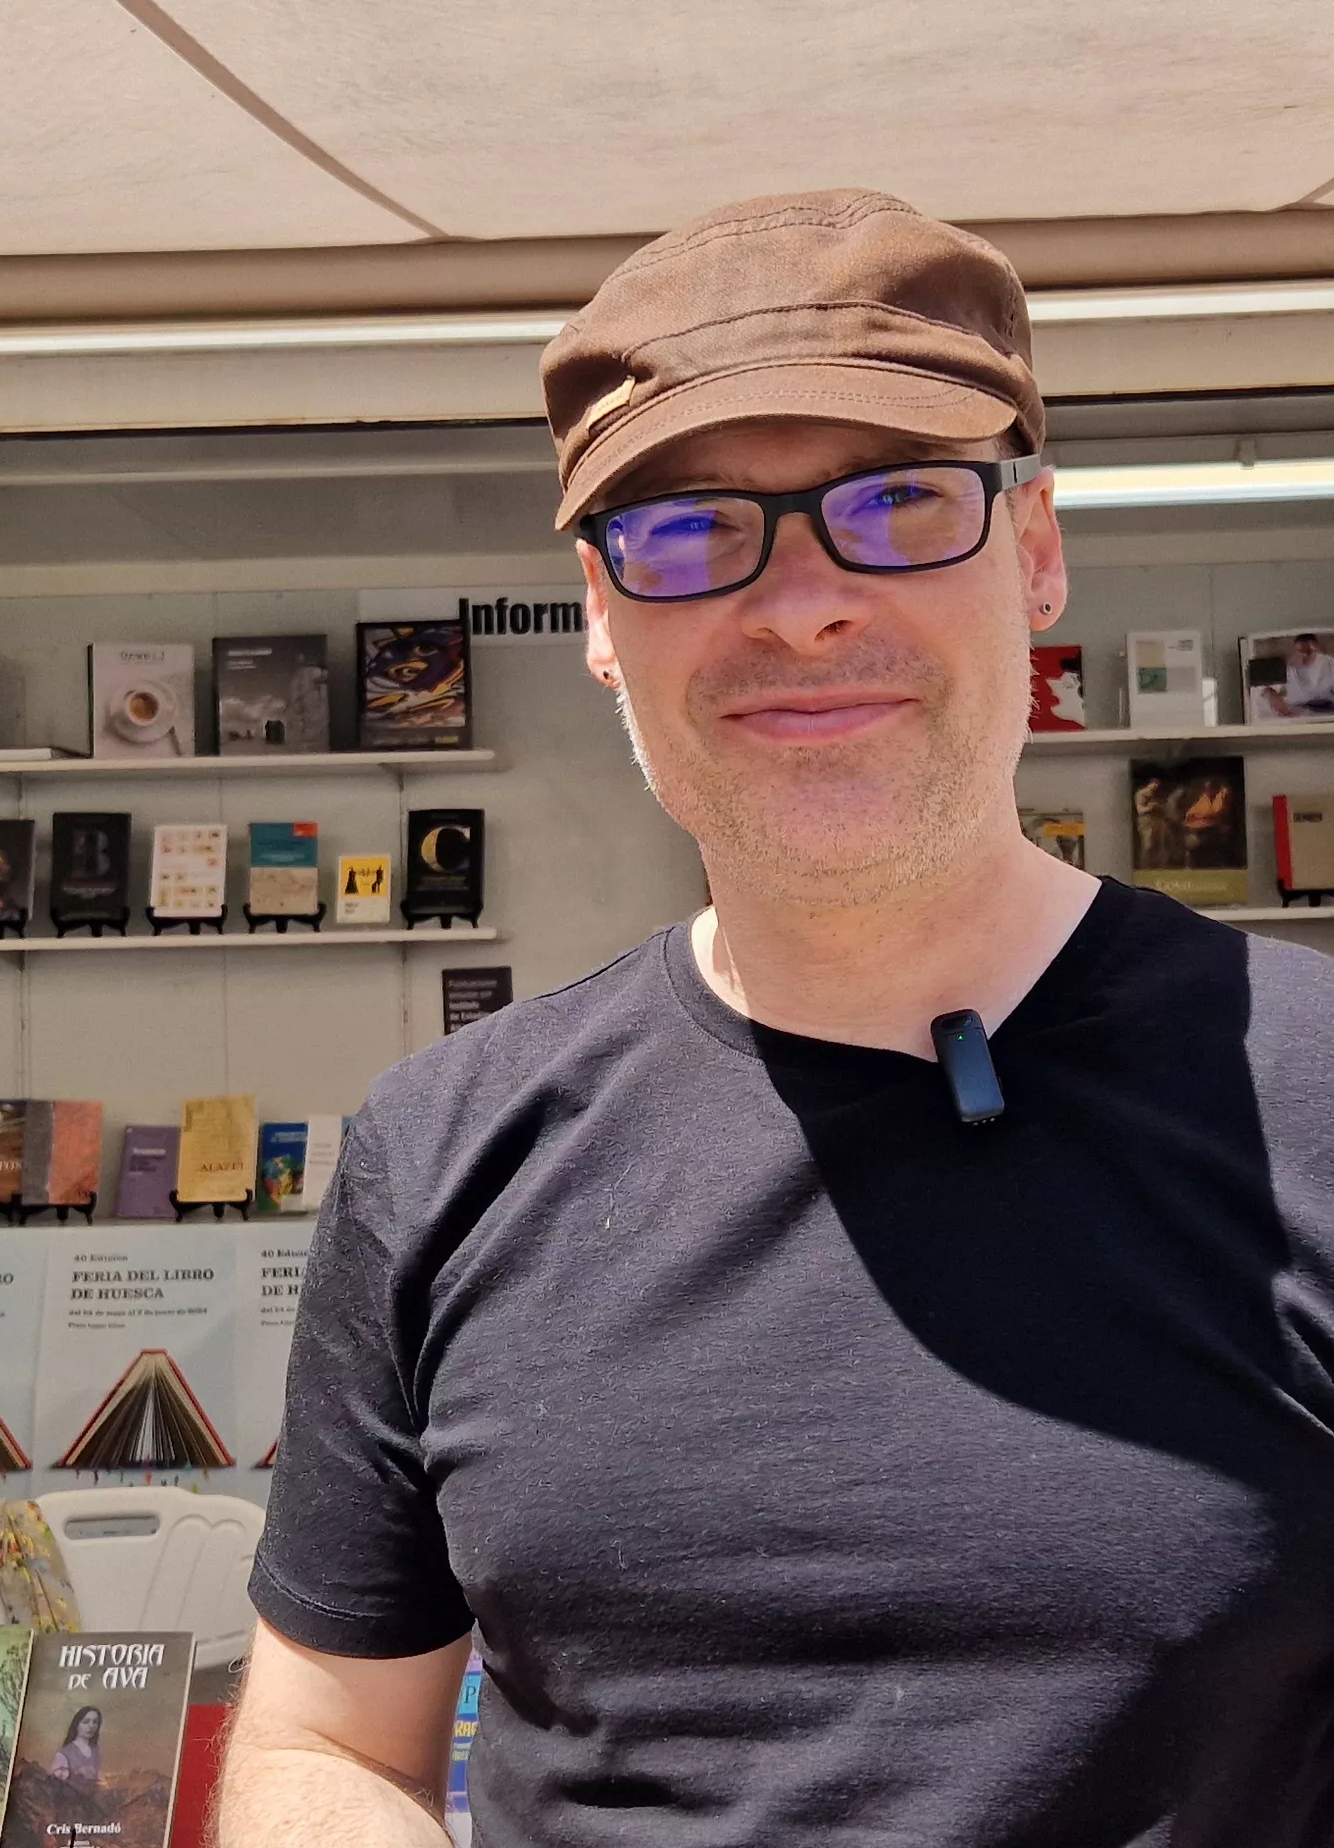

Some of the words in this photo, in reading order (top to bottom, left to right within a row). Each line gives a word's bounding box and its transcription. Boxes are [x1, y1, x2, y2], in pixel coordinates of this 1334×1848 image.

[458, 596, 583, 635] Inform
[72, 1270, 123, 1283] FERIA
[127, 1269, 160, 1282] DEL
[163, 1268, 215, 1281] LIBRO
[261, 1267, 304, 1278] FERI
[71, 1288, 94, 1300] DE
[97, 1287, 165, 1300] HUESCA
[261, 1284, 284, 1296] DE
[58, 1643, 165, 1668] HISTORIA
[68, 1673, 92, 1690] DE
[102, 1666, 149, 1690] AVA
[46, 1823, 71, 1835] Cris
[73, 1822, 121, 1834] Bernadó
